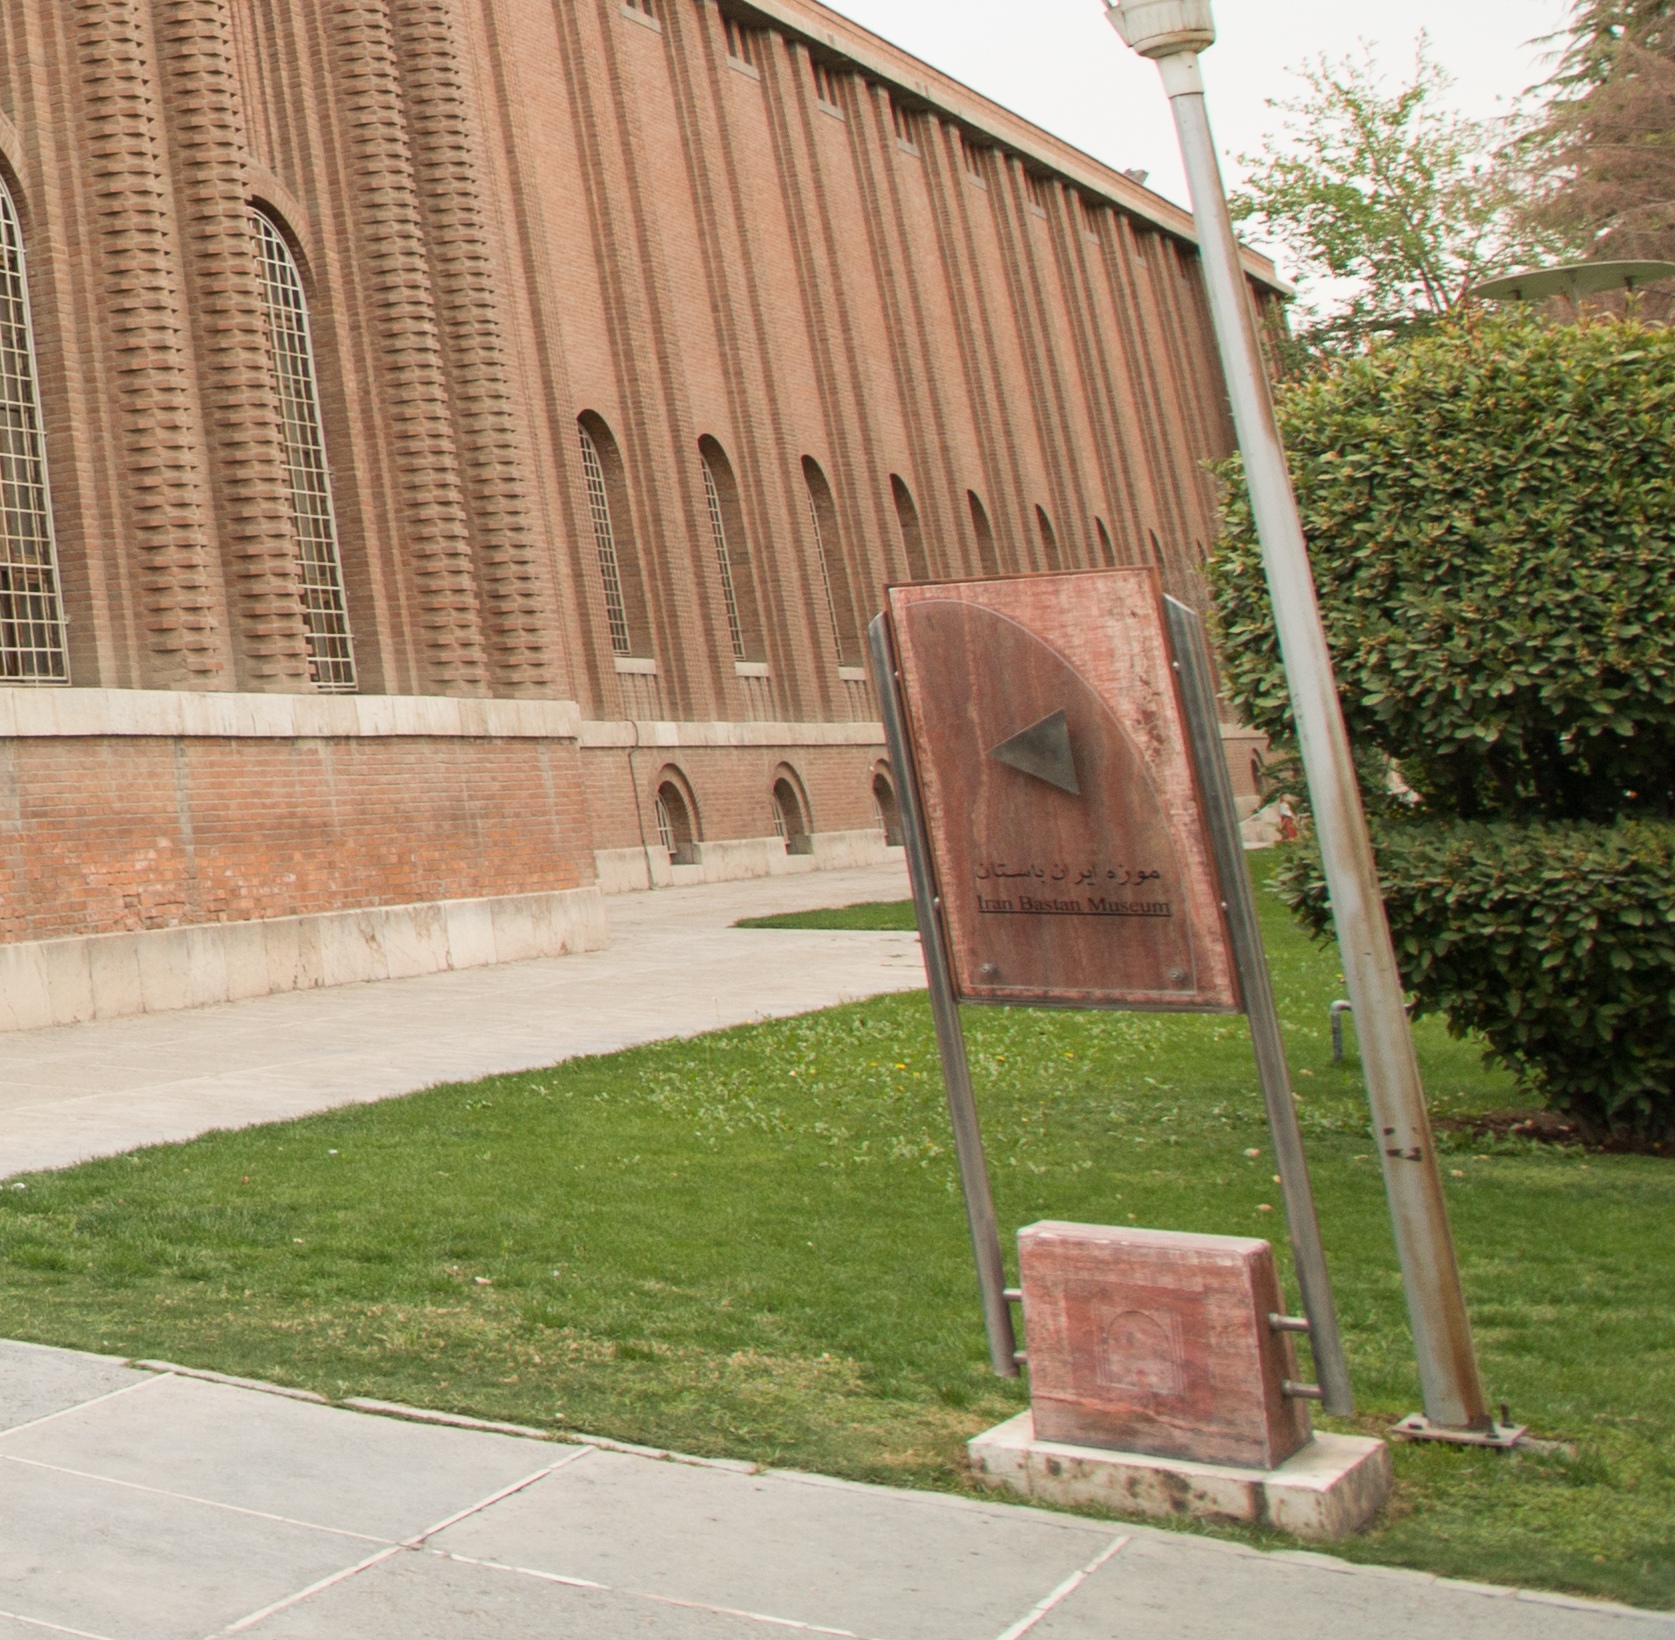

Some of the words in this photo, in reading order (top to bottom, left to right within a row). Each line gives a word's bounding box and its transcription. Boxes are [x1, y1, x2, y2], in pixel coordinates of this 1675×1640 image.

[977, 862, 1046, 884] باستان
[1051, 863, 1096, 886] ایران
[1106, 863, 1161, 886] موزه
[977, 894, 1014, 911] Iran
[1019, 895, 1081, 912] Bastan
[1087, 896, 1172, 914] Museum
